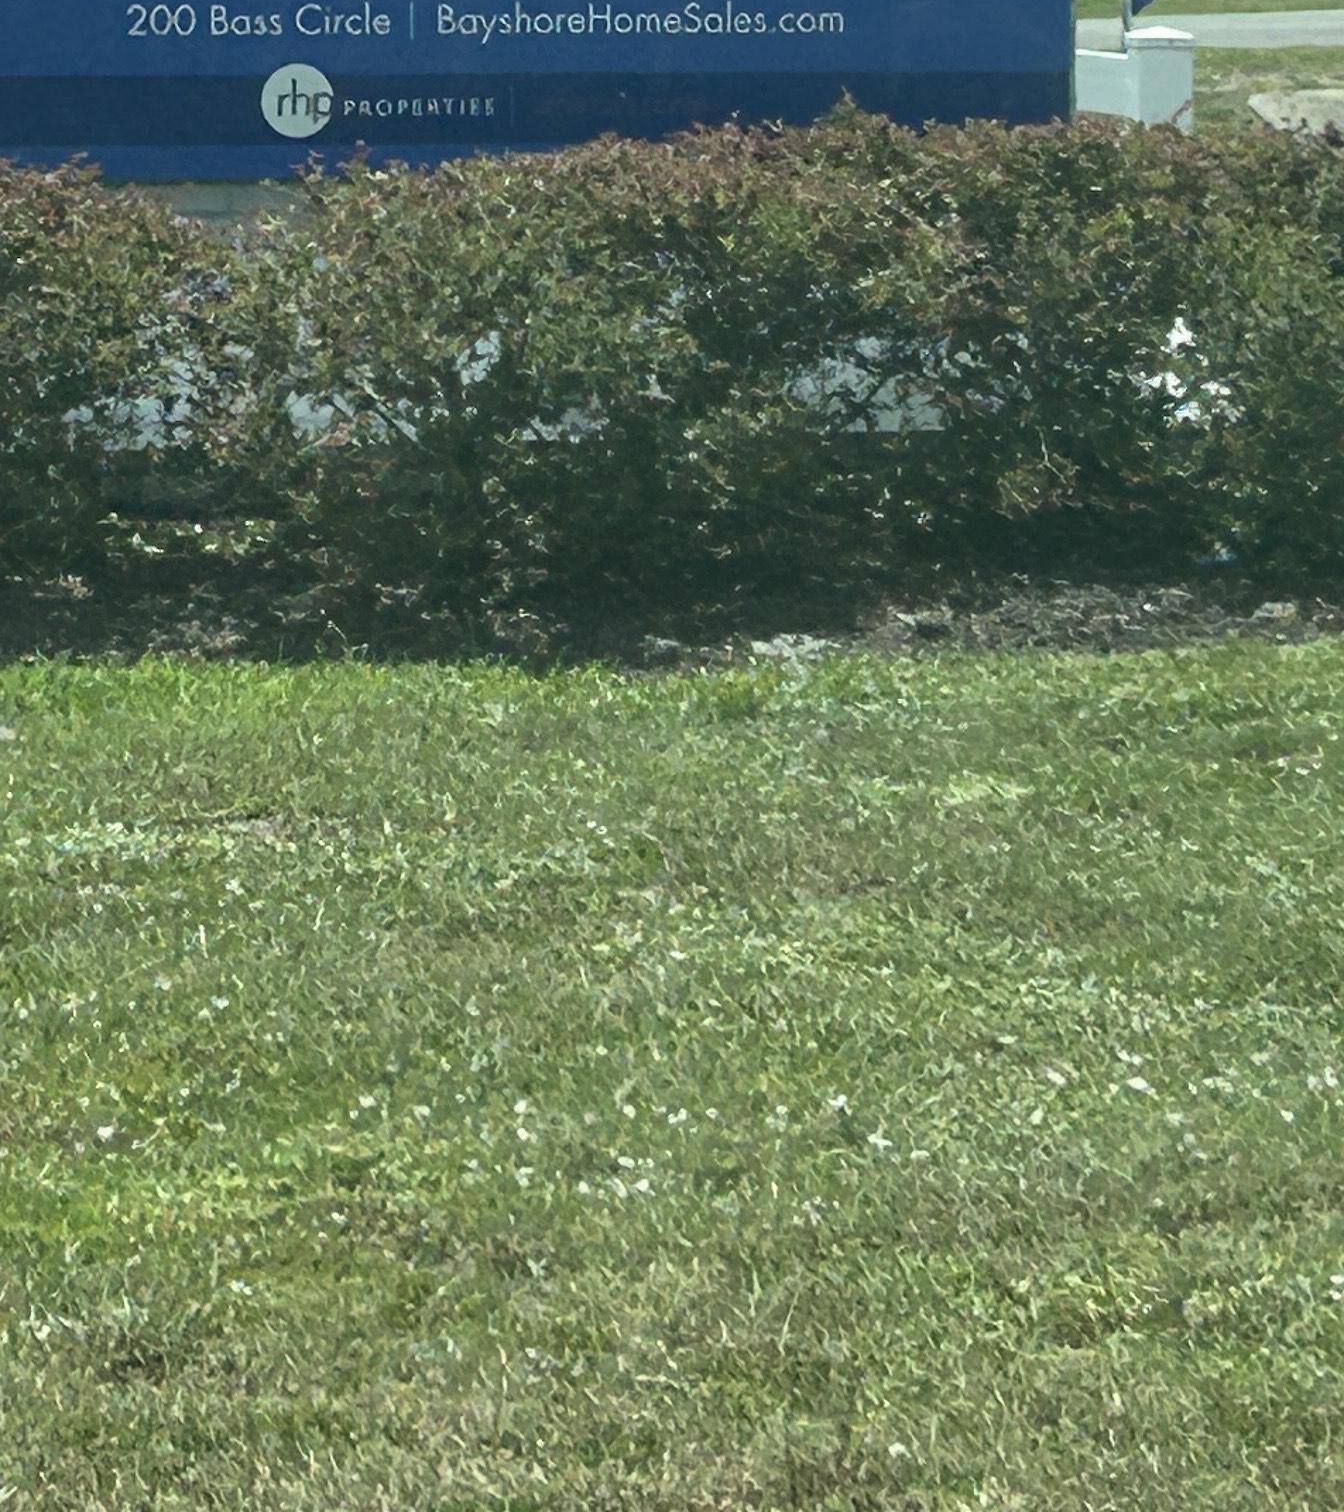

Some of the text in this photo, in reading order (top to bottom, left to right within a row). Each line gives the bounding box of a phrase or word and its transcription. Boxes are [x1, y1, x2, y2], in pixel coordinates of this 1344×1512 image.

[126, 1, 844, 45] 200 Bass Circle BayshoreHomeSales.com
[276, 78, 334, 124] rhp
